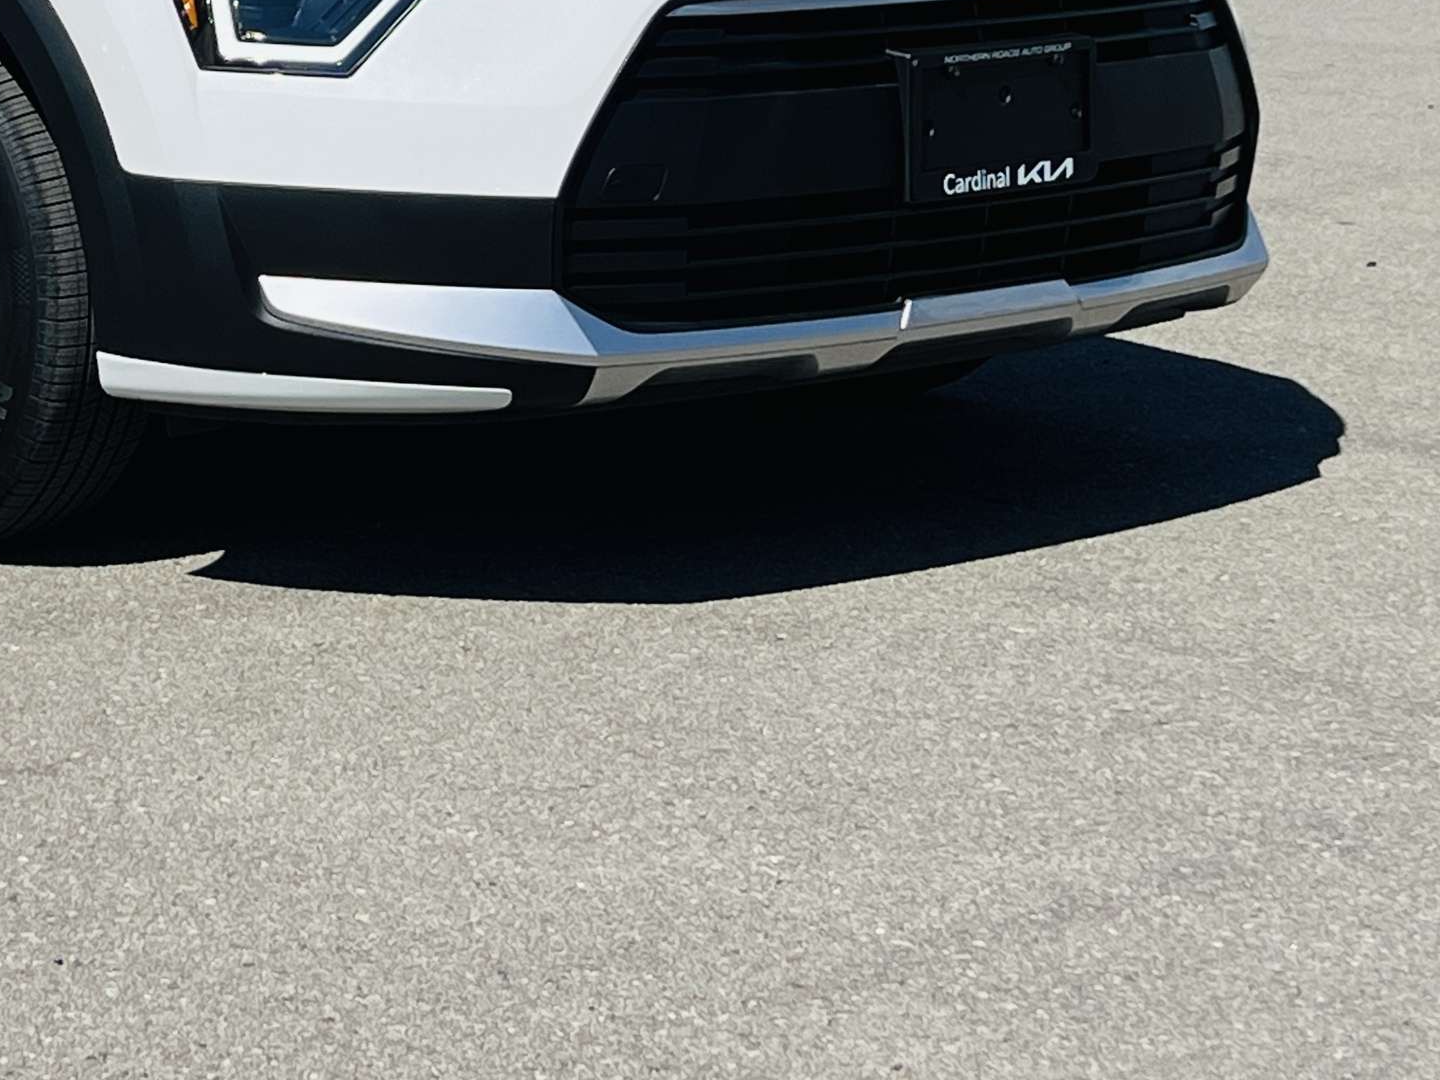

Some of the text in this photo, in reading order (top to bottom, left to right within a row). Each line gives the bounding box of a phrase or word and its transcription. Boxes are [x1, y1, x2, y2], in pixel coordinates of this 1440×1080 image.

[1021, 45, 1043, 56] AUTO
[1044, 41, 1073, 54] GROUP
[943, 157, 1074, 195] Cardinal KIA
